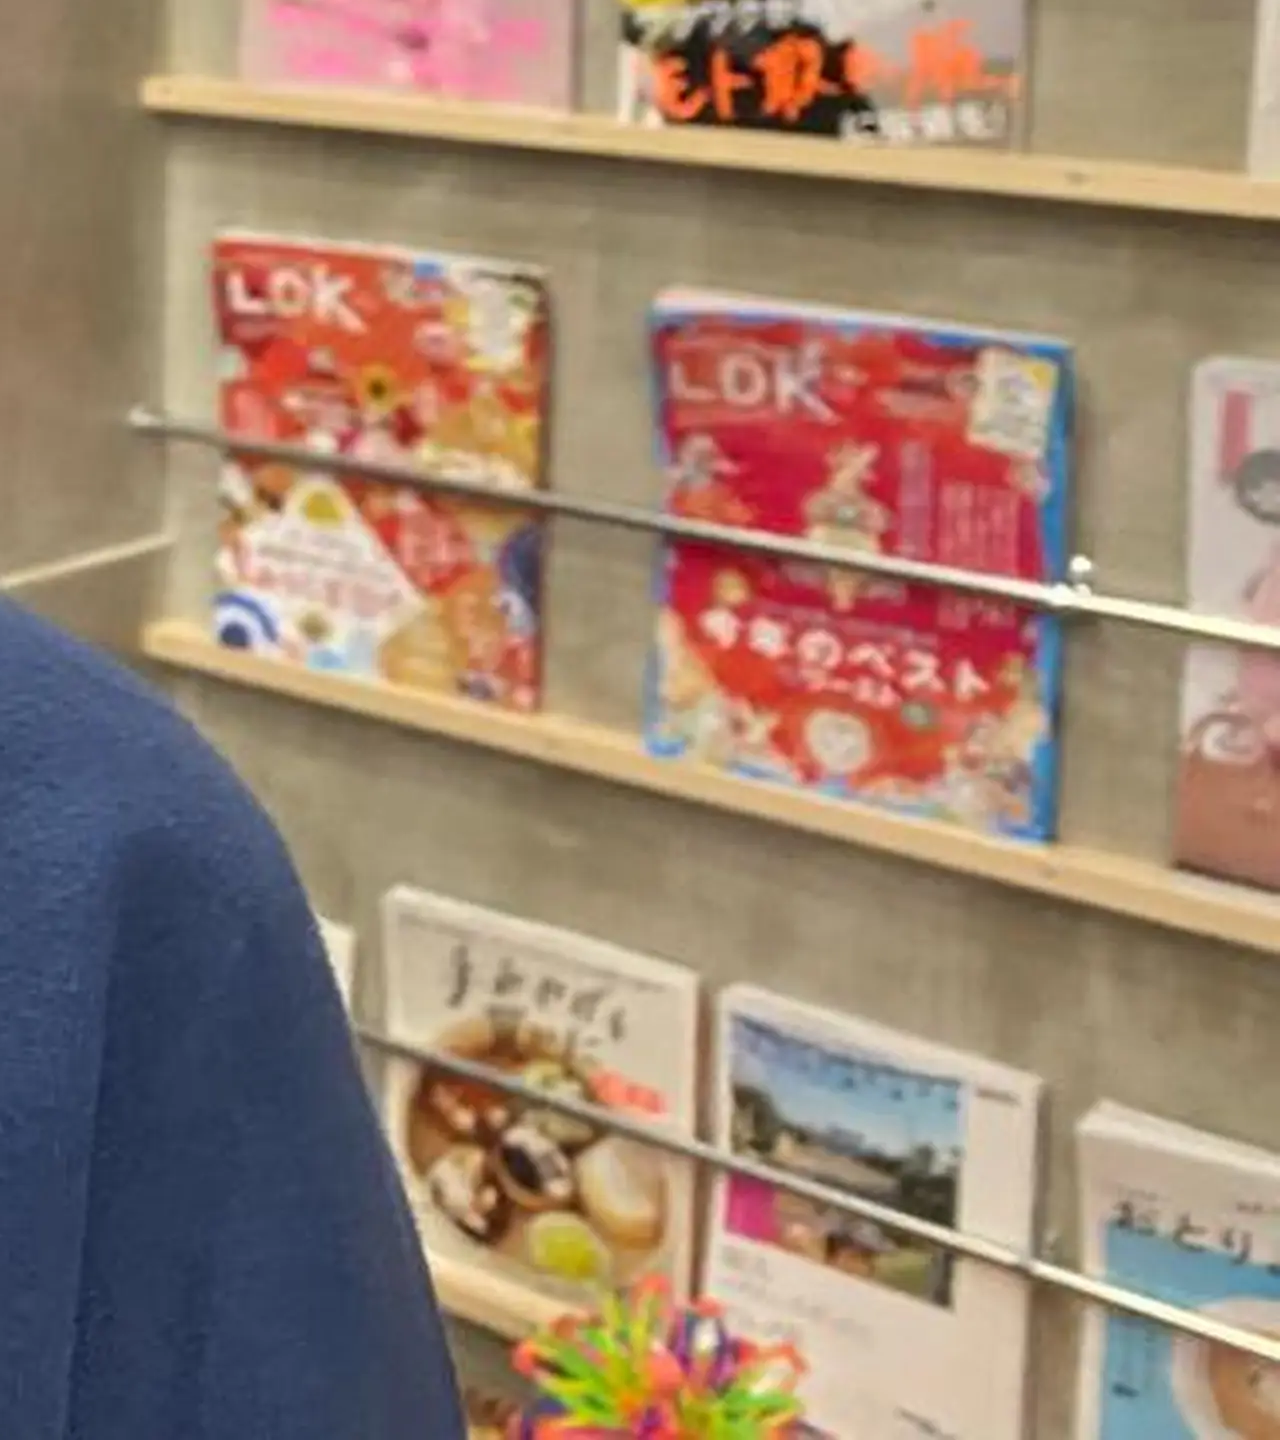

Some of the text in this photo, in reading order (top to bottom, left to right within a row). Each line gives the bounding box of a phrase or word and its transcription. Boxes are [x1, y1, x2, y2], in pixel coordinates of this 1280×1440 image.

[225, 262, 368, 335] LDK
[668, 341, 843, 427] LDK
[697, 607, 991, 703] 今年のベスト
